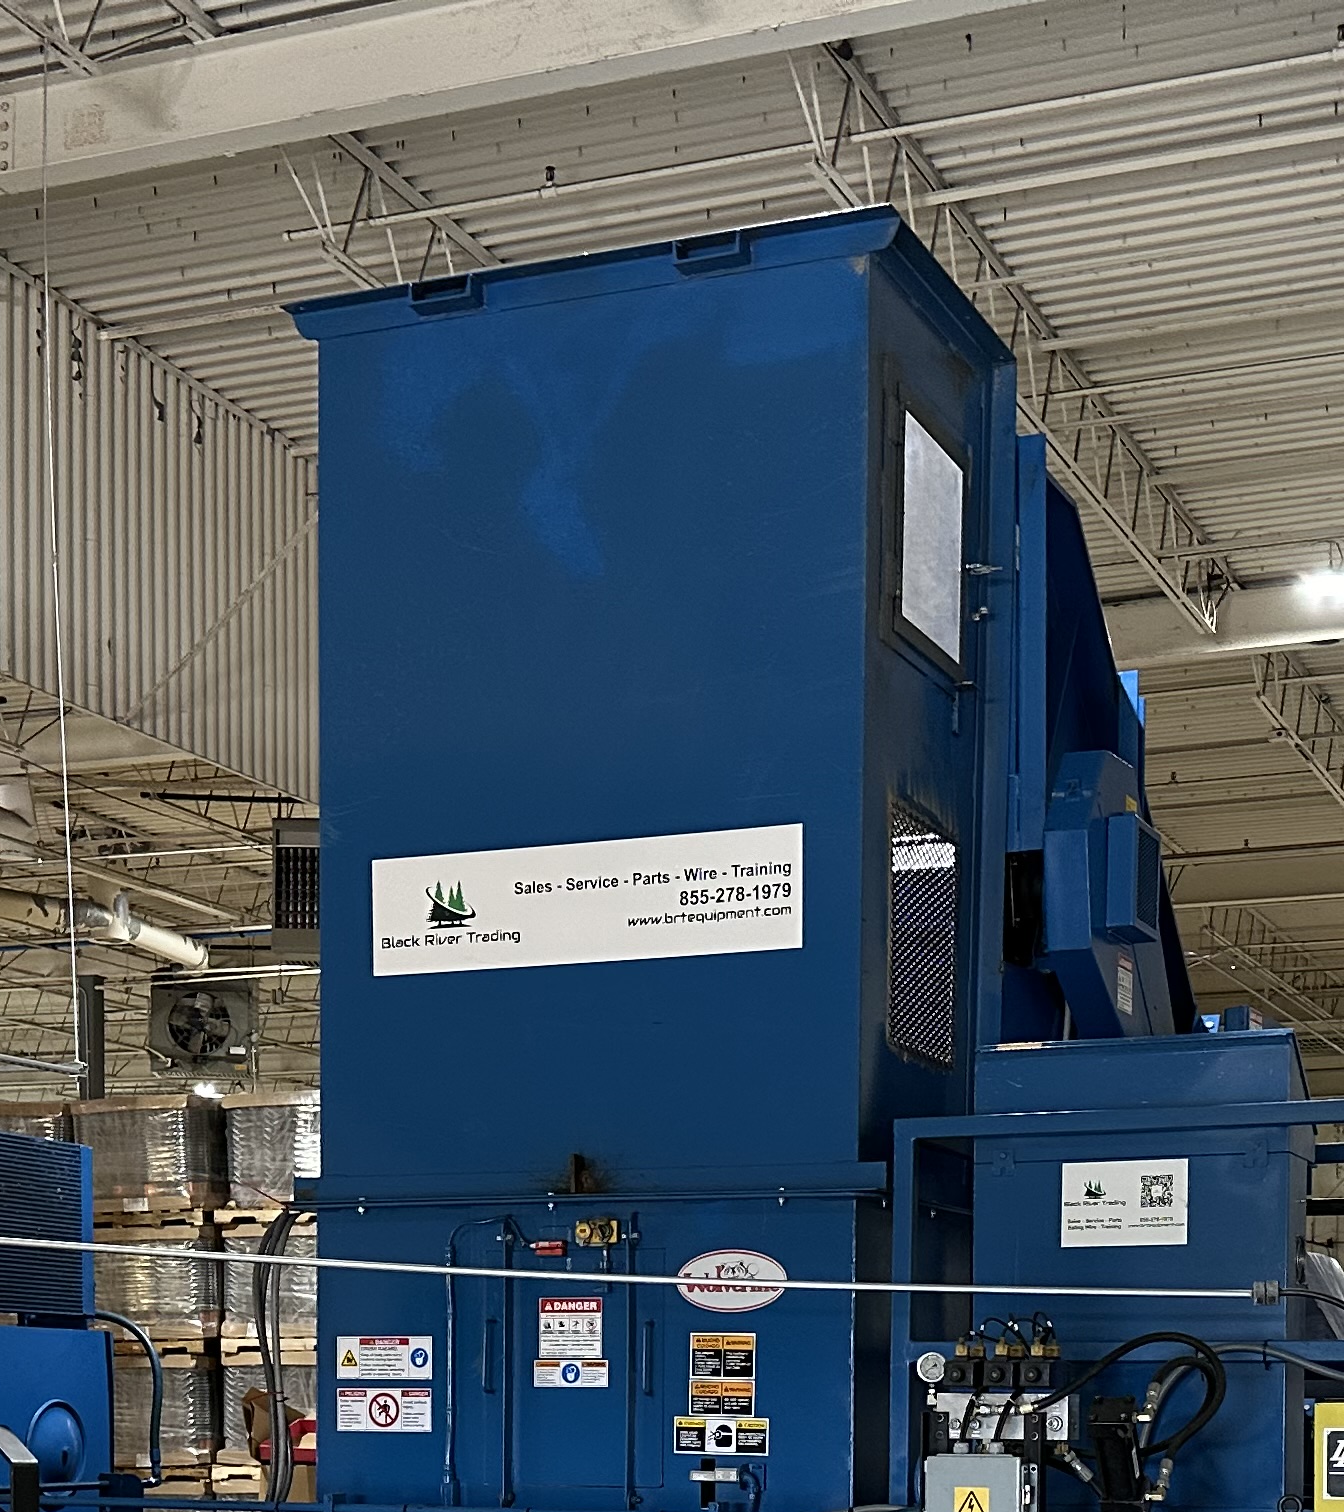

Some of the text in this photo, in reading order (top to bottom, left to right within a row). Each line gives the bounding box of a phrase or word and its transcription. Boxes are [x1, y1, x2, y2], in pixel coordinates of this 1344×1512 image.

[514, 880, 553, 895] Sales
[566, 876, 619, 891] Service
[632, 872, 670, 886] Parts
[684, 868, 718, 882] Wire
[731, 861, 792, 878] Training
[679, 882, 792, 906] 855-278-1979
[628, 906, 792, 927] www.brtequipment.com
[381, 929, 521, 949] Black River Trading
[553, 1301, 597, 1310] DANGER
